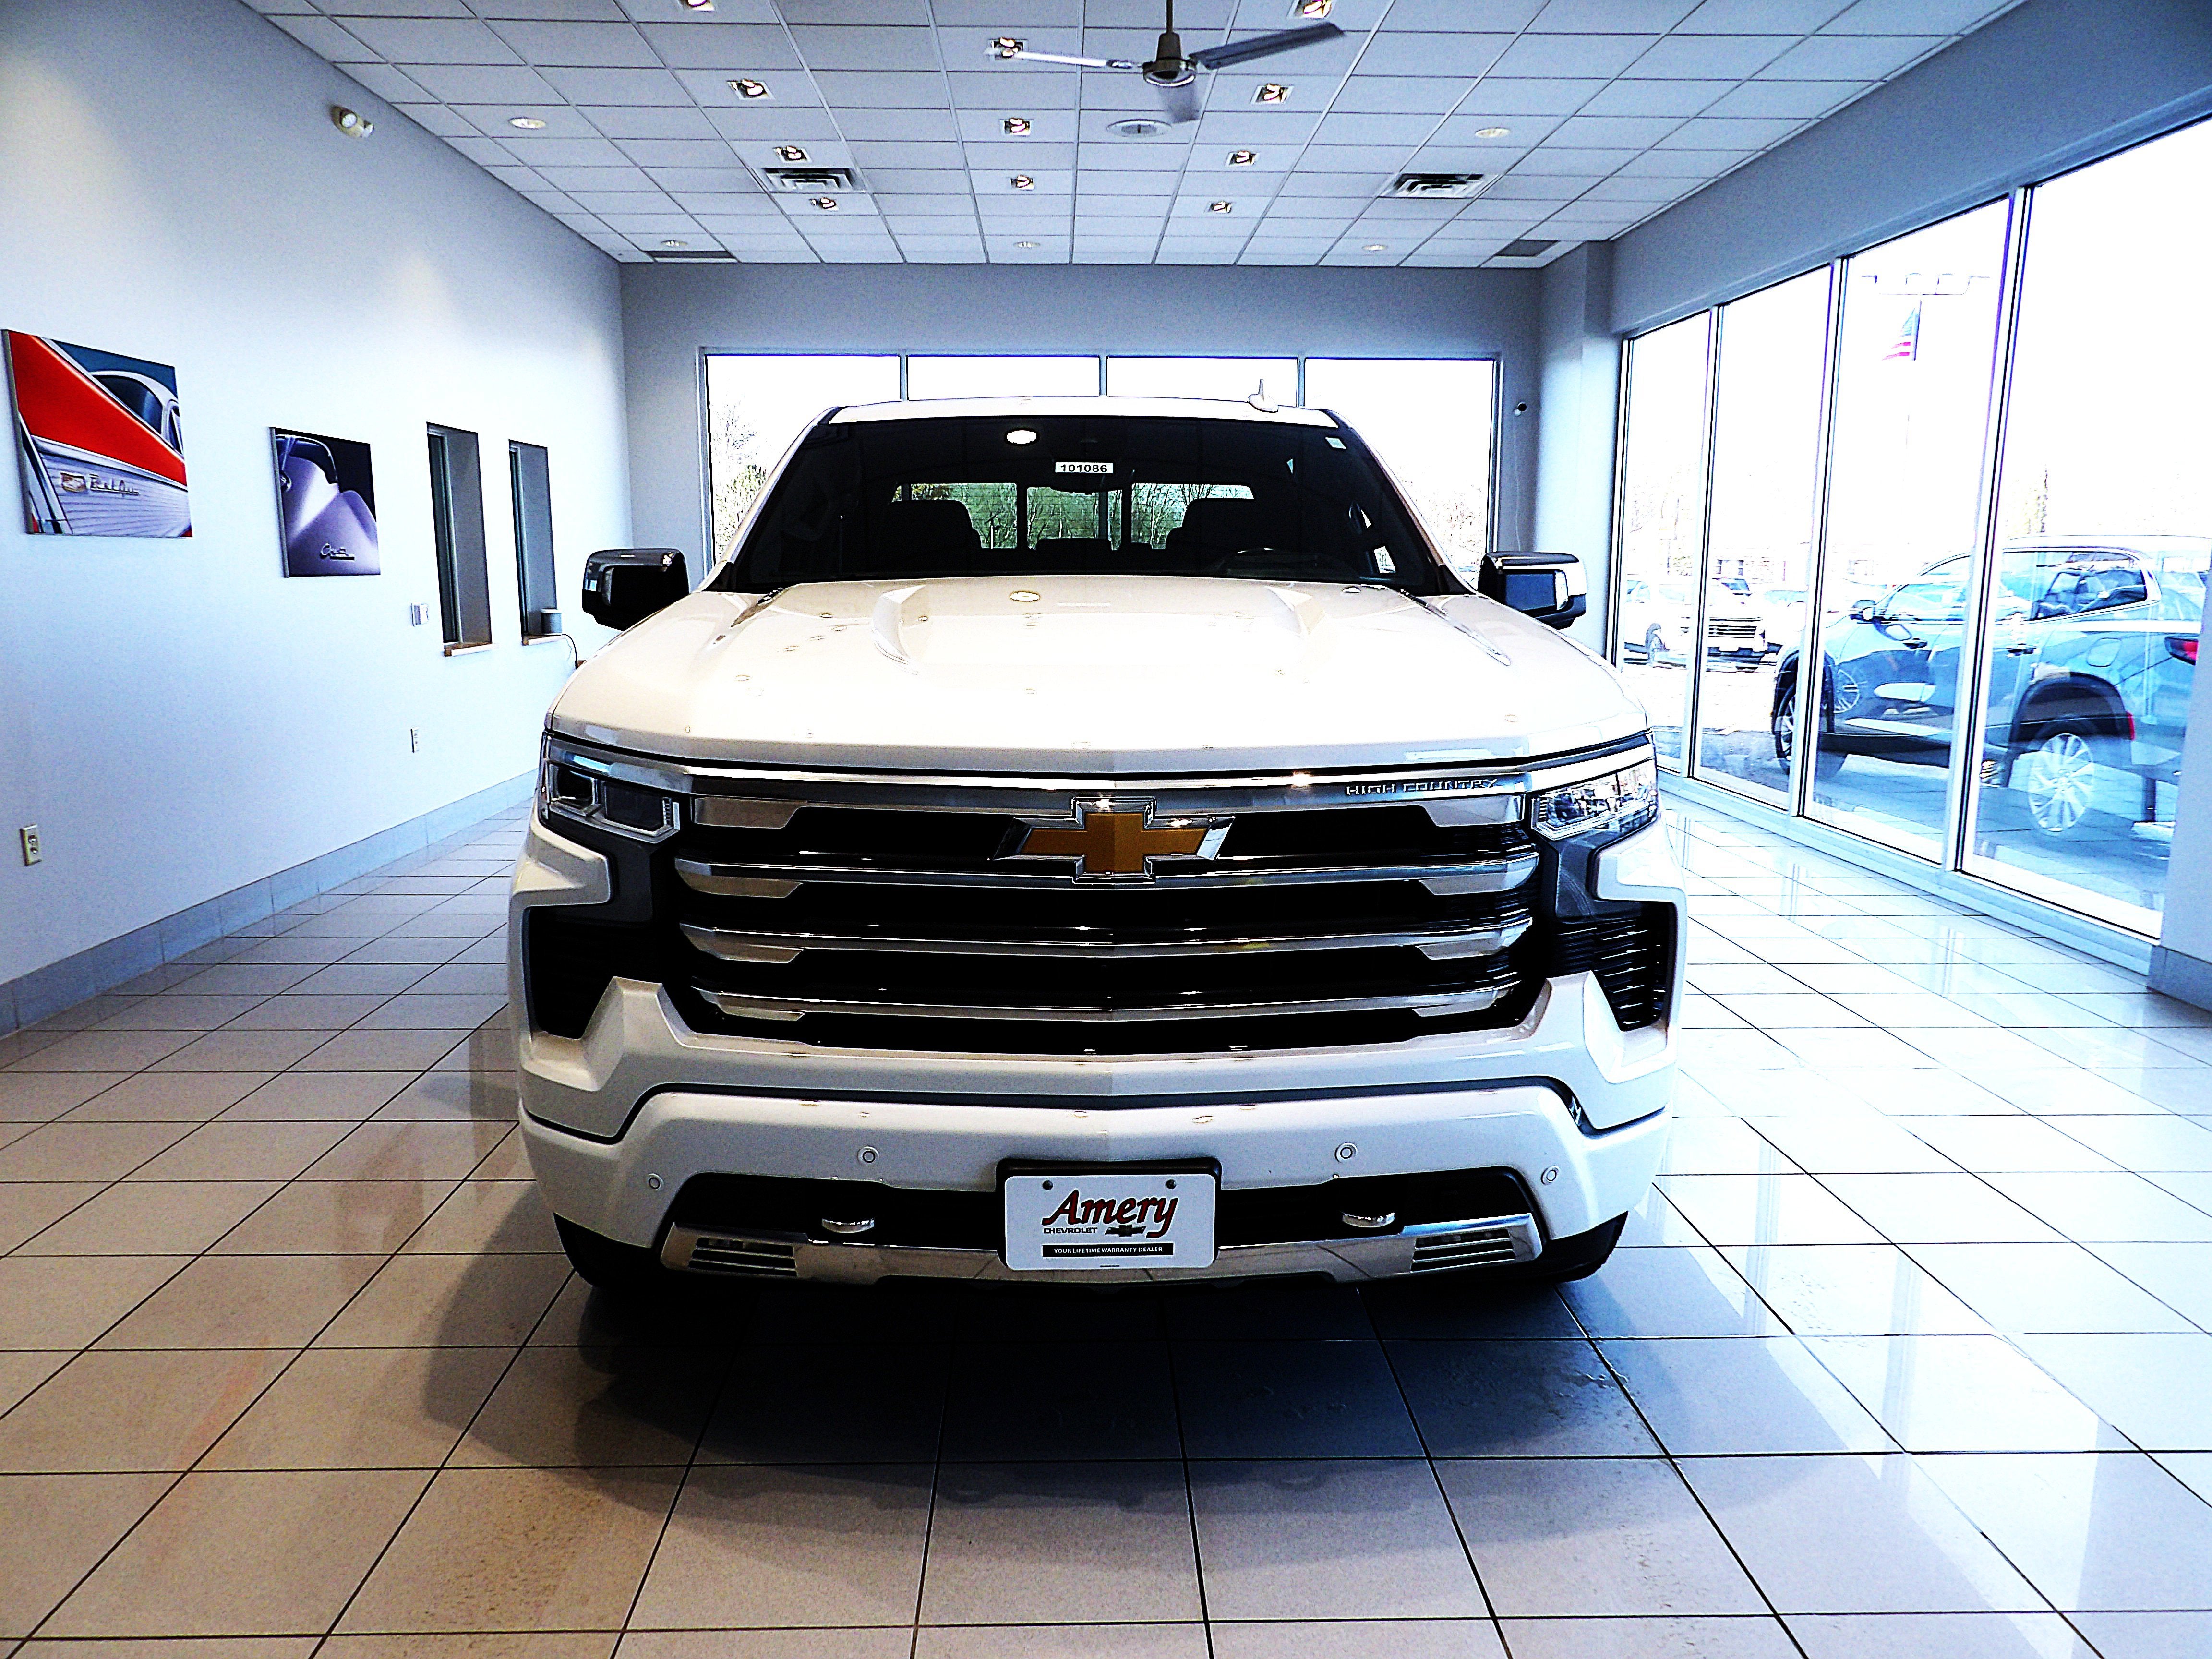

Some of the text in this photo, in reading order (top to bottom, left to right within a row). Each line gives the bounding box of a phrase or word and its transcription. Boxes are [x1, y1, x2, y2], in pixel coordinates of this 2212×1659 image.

[1060, 464, 1108, 472] 101086
[1346, 778, 1498, 795] HIGH COUNTRY
[1041, 1189, 1178, 1238] Amery
